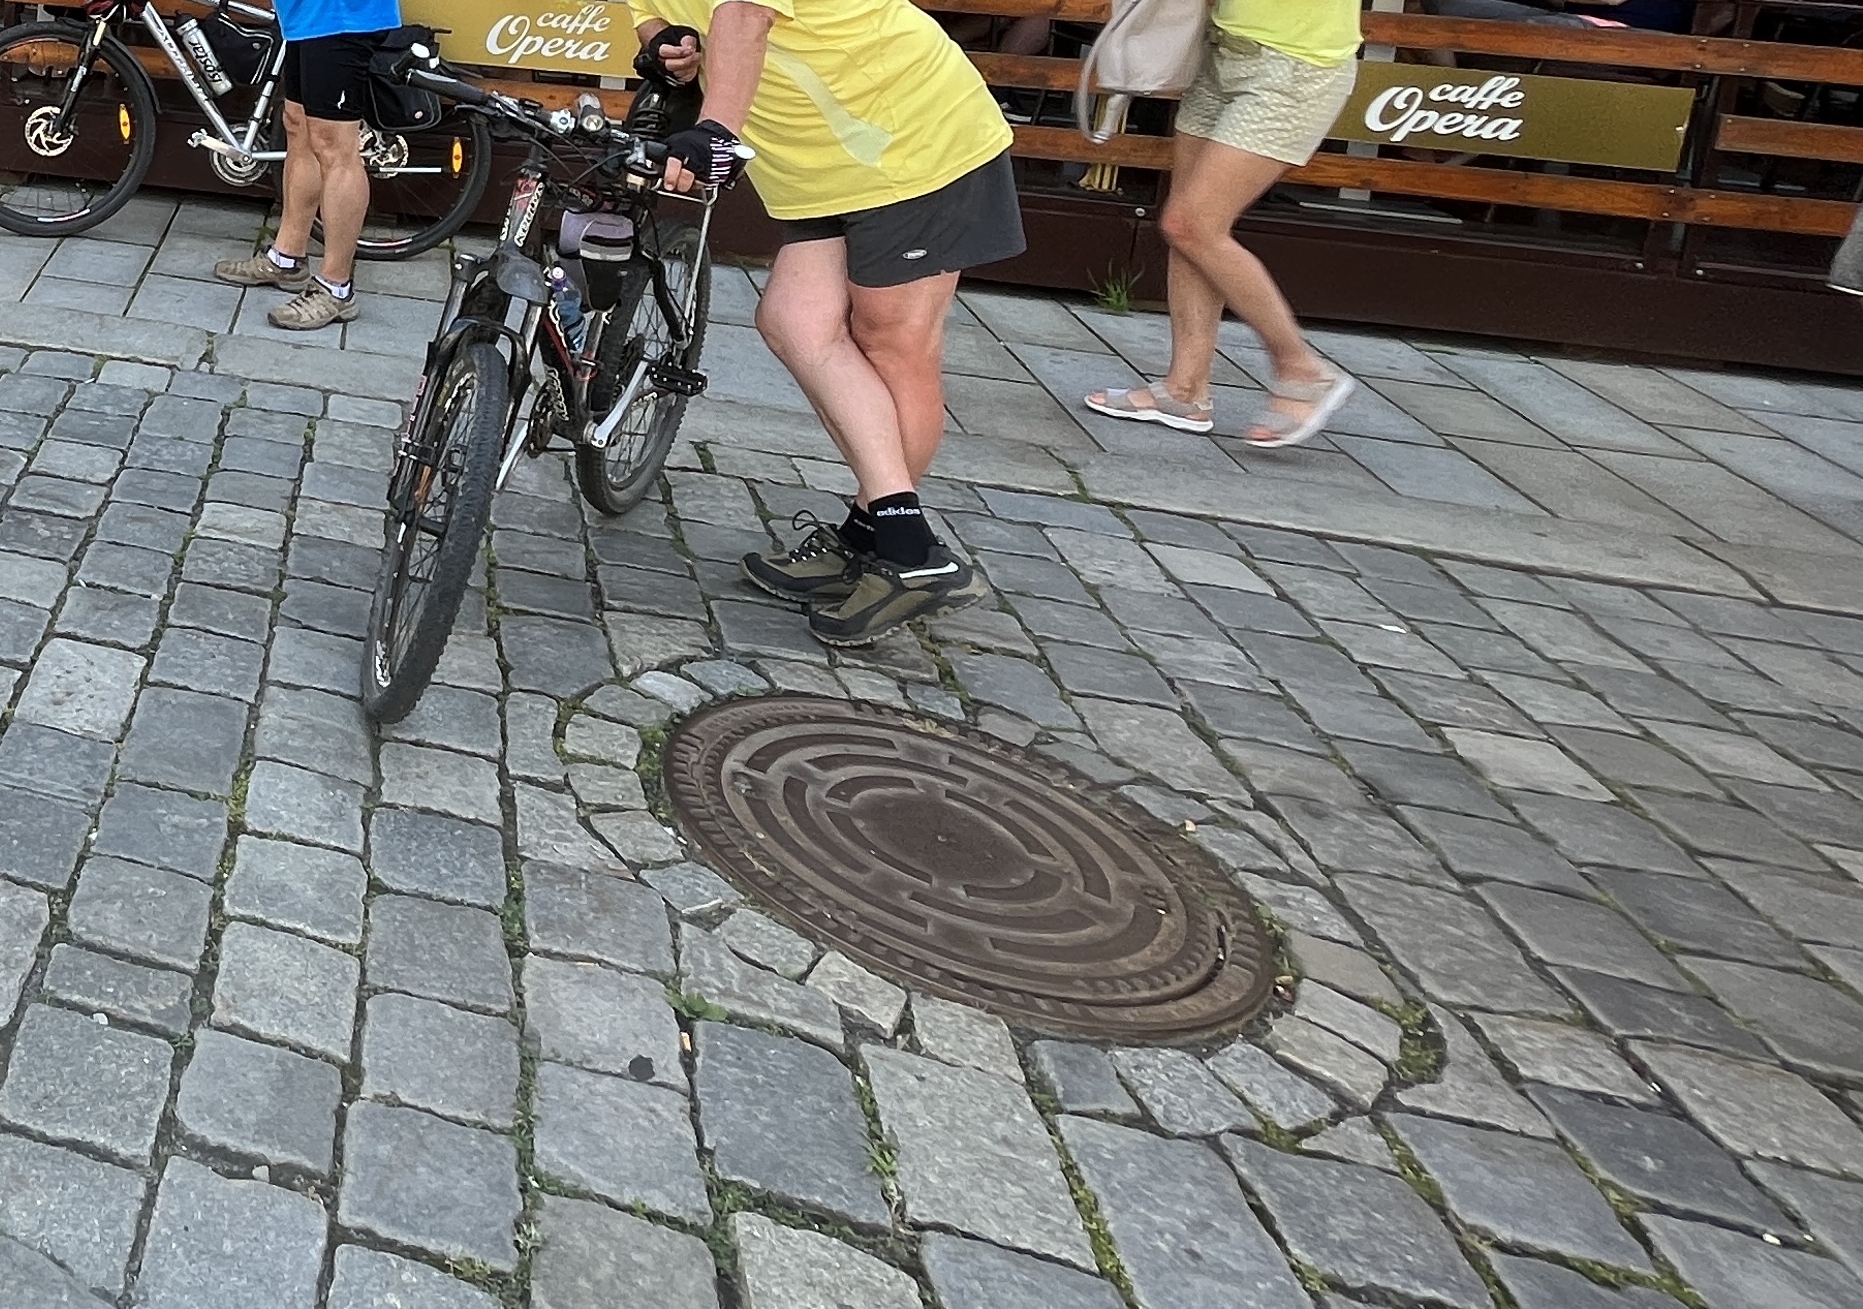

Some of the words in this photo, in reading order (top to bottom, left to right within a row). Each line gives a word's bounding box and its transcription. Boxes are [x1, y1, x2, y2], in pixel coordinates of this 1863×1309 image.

[485, 14, 611, 64] Opera
[536, 4, 611, 35] caffe
[1364, 86, 1525, 142] Opera
[1428, 75, 1526, 111] caffe
